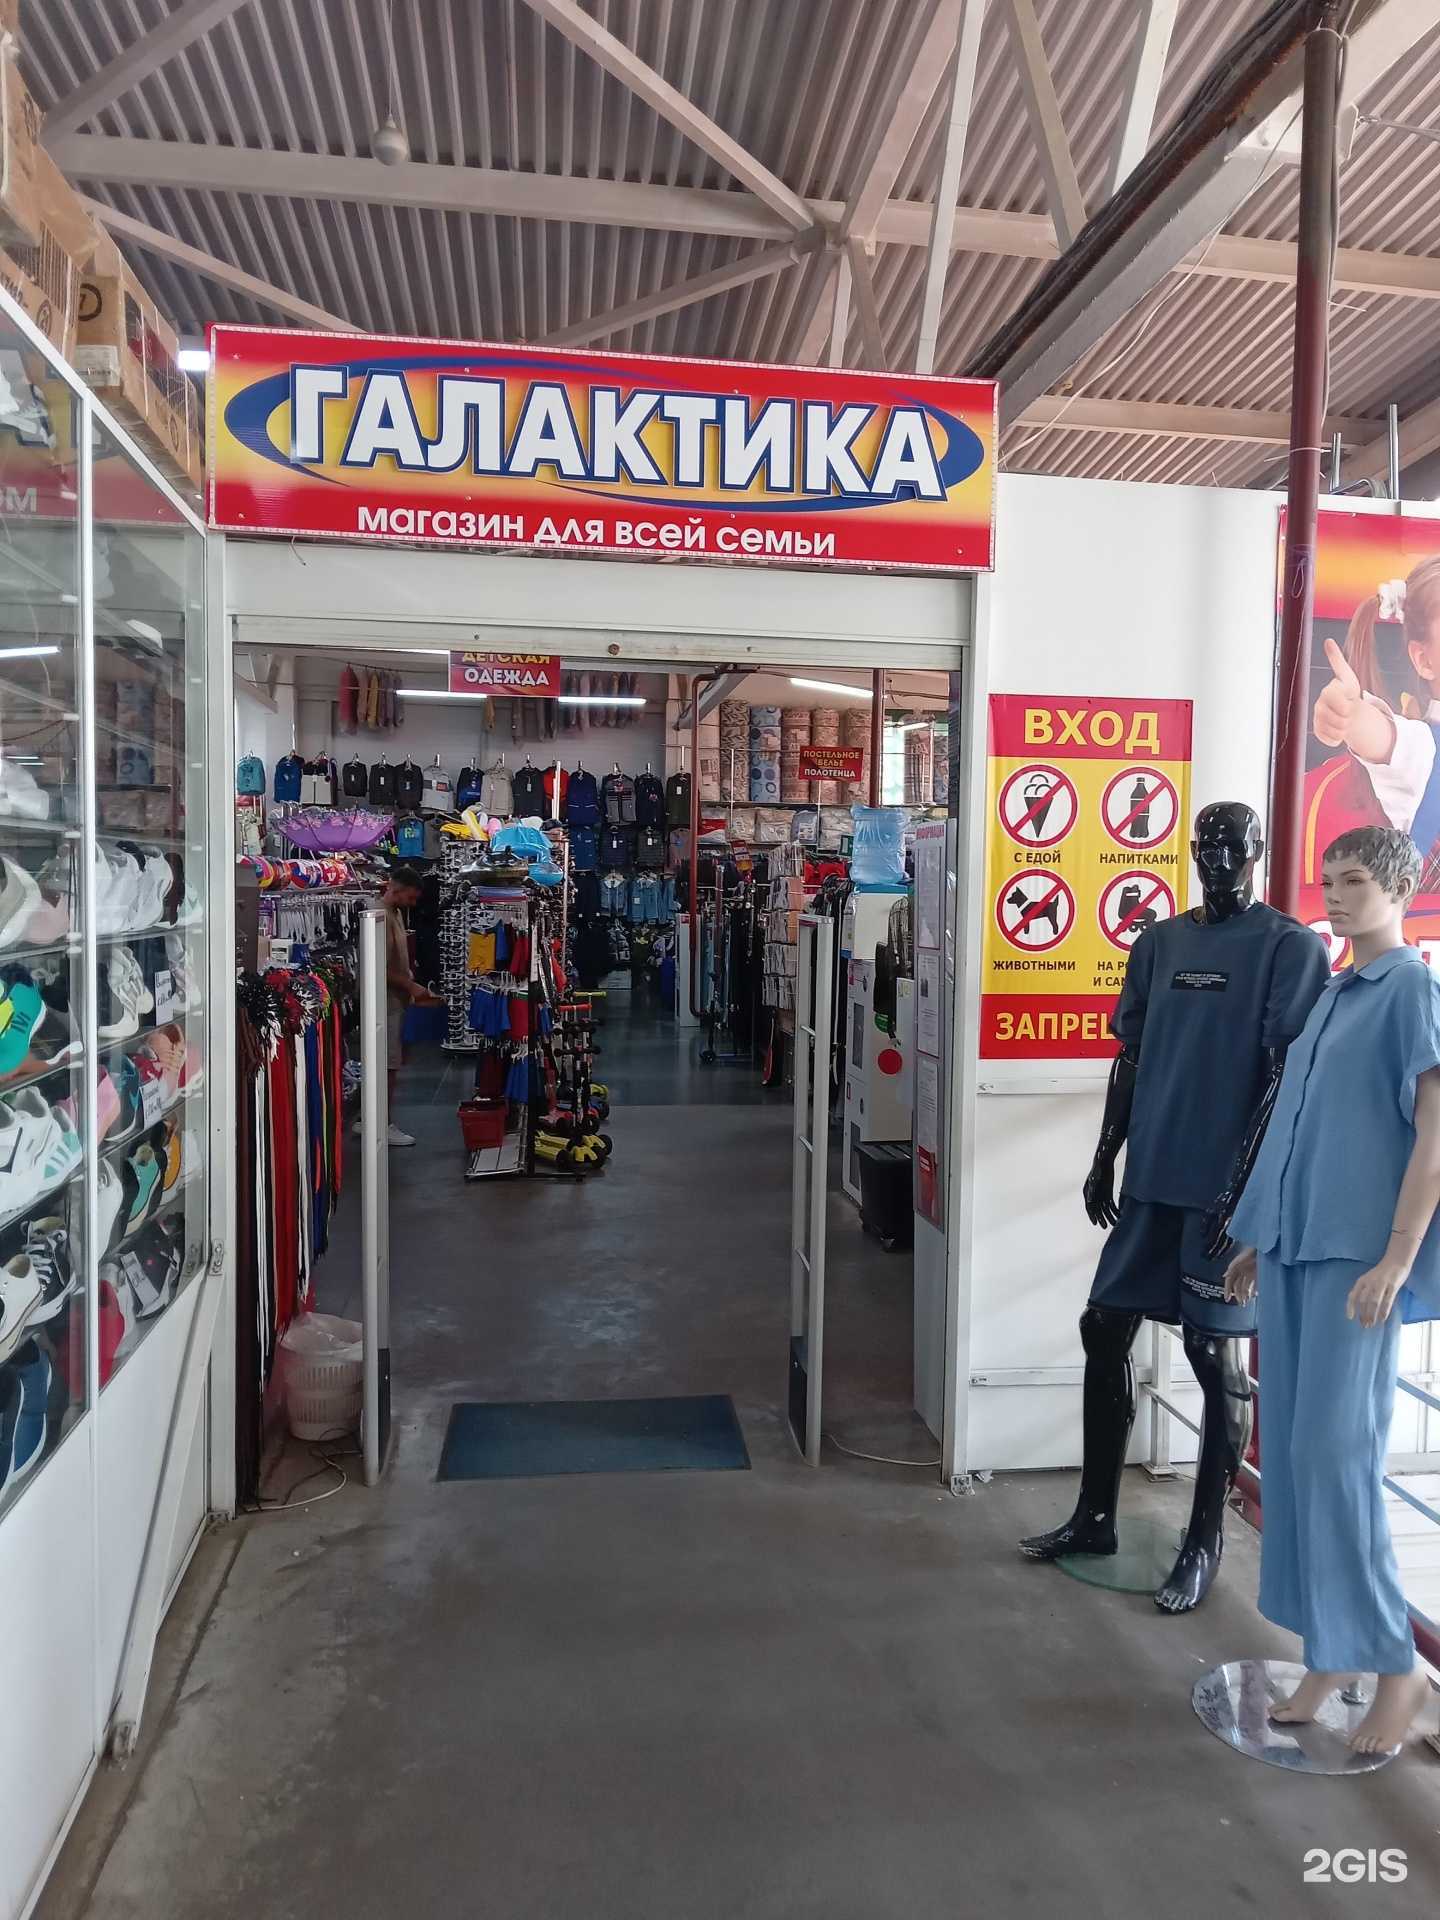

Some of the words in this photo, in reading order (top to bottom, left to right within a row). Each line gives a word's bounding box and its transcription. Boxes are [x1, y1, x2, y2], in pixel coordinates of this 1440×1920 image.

[290, 363, 948, 502] ГАЛАКТИКА
[358, 506, 524, 539] магазин
[534, 516, 604, 545] для
[615, 517, 706, 549] всей
[716, 526, 835, 556] семьи
[464, 667, 550, 686] ОДЕЖДА
[1024, 707, 1161, 755] ВХОД
[803, 750, 861, 759] ПОСТЕЛЬНОЕ
[804, 768, 856, 778] ПОЛОТЕНЦА
[1014, 852, 1023, 864] С
[1026, 851, 1061, 866] ЕДОЙ
[1099, 853, 1179, 866] НАПИТКАМИ
[993, 960, 1077, 972] ЖИВОТНЫМИ
[1097, 961, 1114, 971] НА
[1093, 976, 1102, 987] И
